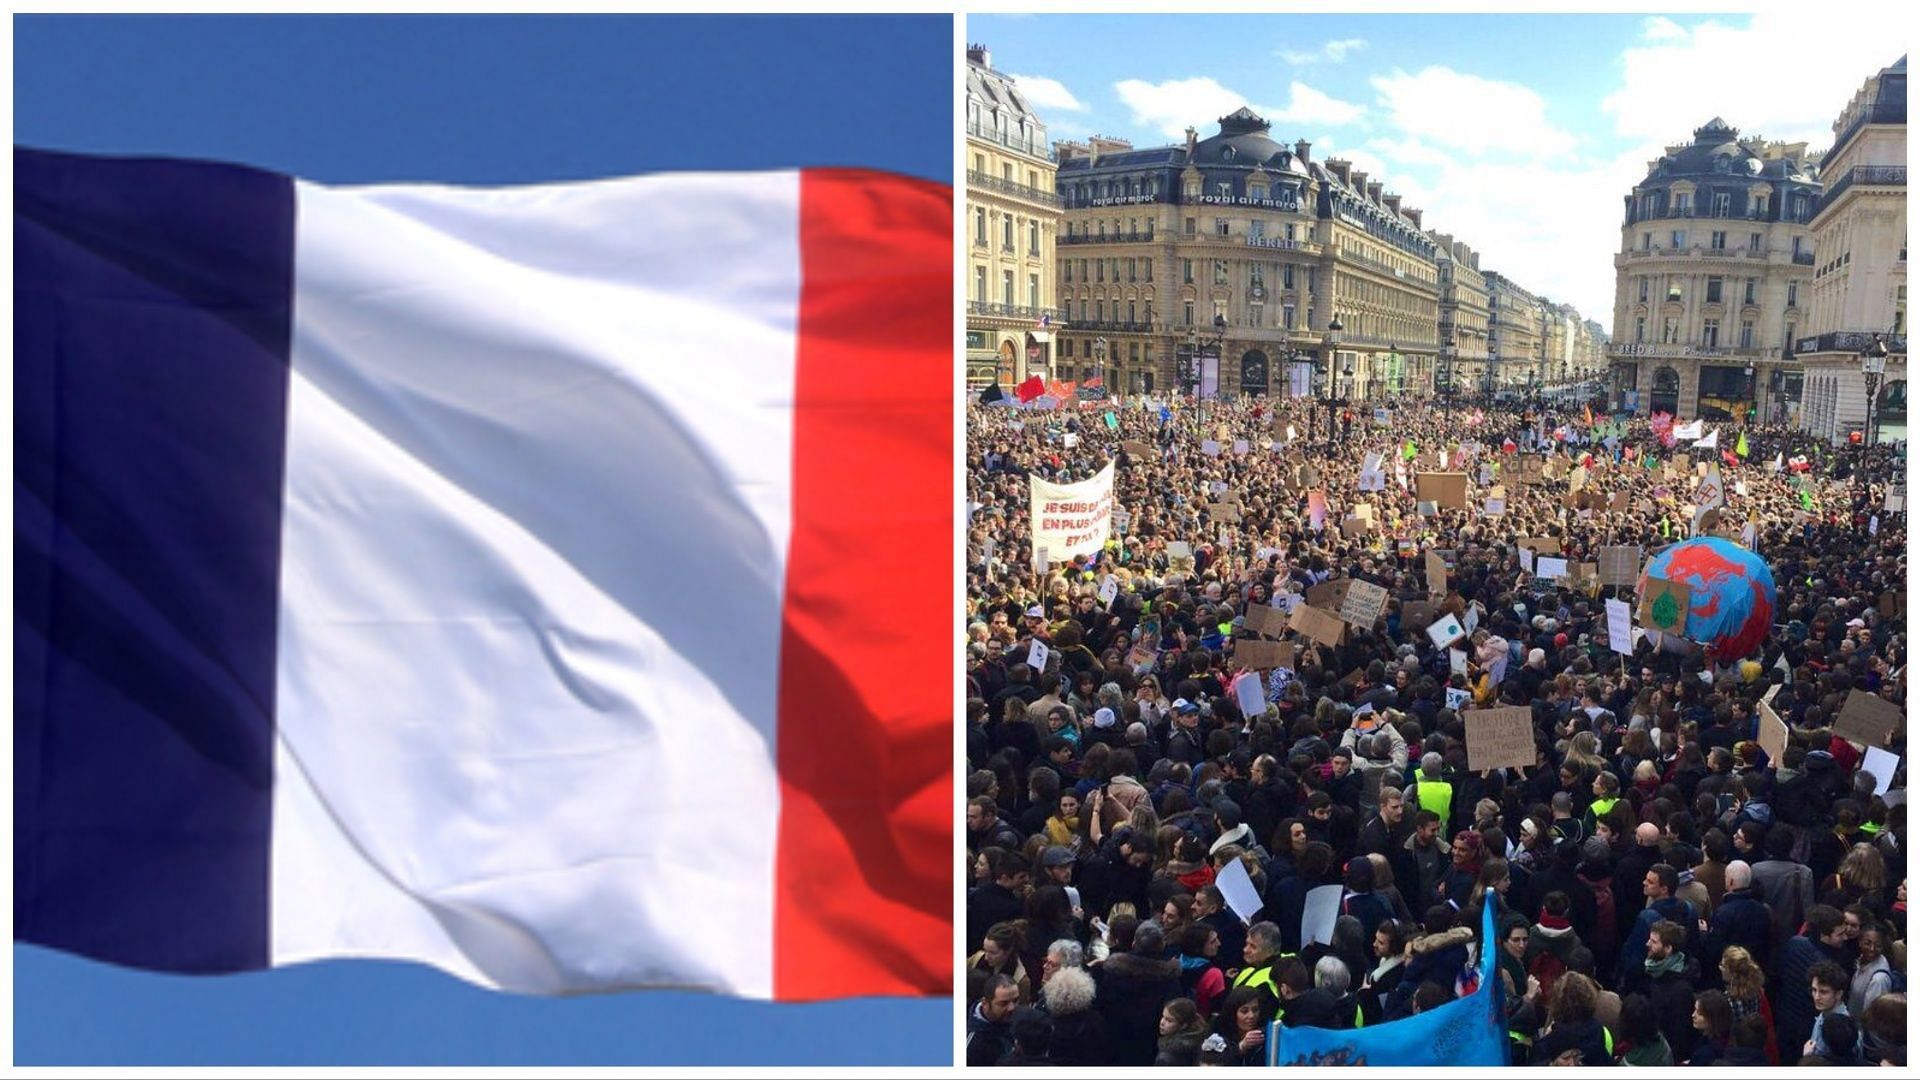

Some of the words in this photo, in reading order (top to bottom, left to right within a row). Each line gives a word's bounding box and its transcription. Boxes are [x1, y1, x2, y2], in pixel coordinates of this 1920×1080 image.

[1200, 194, 1235, 204] royal
[1239, 196, 1259, 205] air
[1042, 502, 1058, 513] JE
[1060, 502, 1087, 513] SUIS
[1042, 518, 1060, 530] EN
[1062, 518, 1090, 530] PLUS
